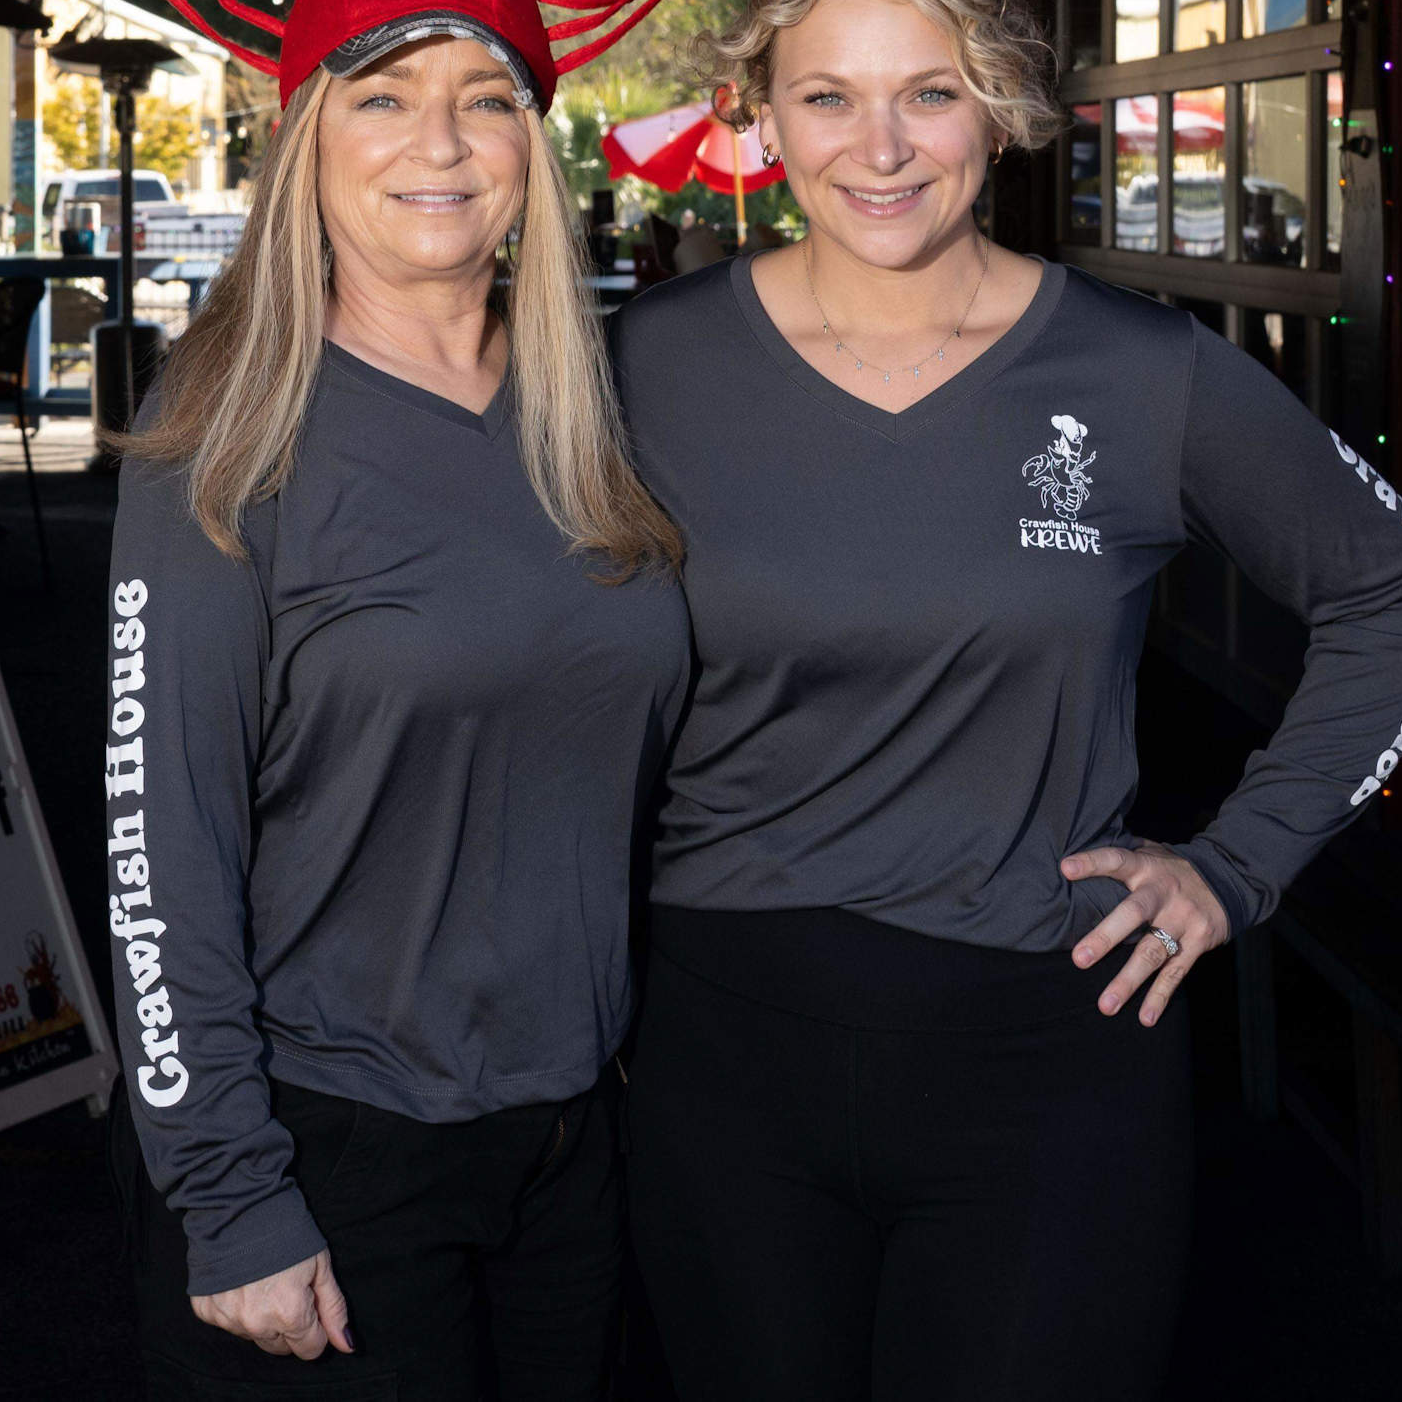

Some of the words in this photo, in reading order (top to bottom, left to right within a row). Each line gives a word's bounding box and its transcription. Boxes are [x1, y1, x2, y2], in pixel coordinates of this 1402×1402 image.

[1019, 518, 1069, 530] Crawfish
[1071, 521, 1100, 537] House
[1021, 528, 1103, 555] KREWE
[105, 578, 149, 802] House
[109, 809, 190, 1108] Crawfish
